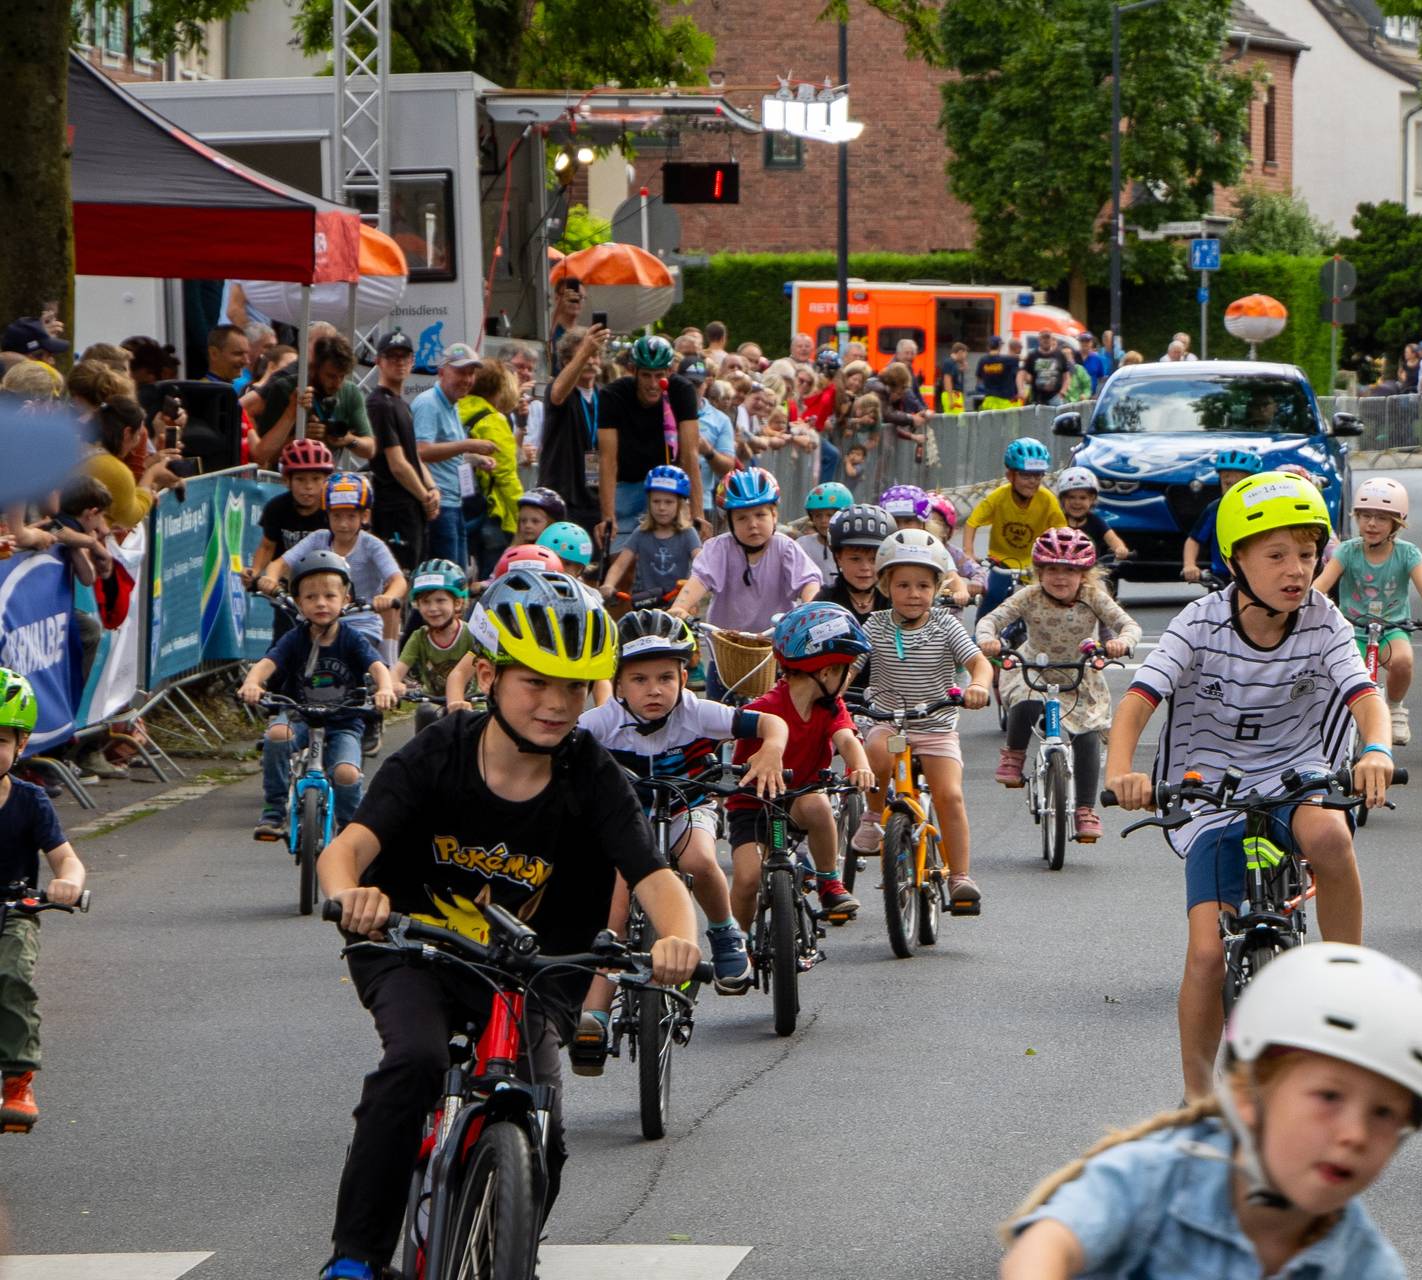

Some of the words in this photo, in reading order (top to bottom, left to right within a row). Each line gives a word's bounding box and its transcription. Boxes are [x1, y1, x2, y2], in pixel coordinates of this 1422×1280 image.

[391, 305, 448, 316] ebnisdienst
[809, 302, 870, 314] RETTNGS
[1235, 713, 1264, 740] 6
